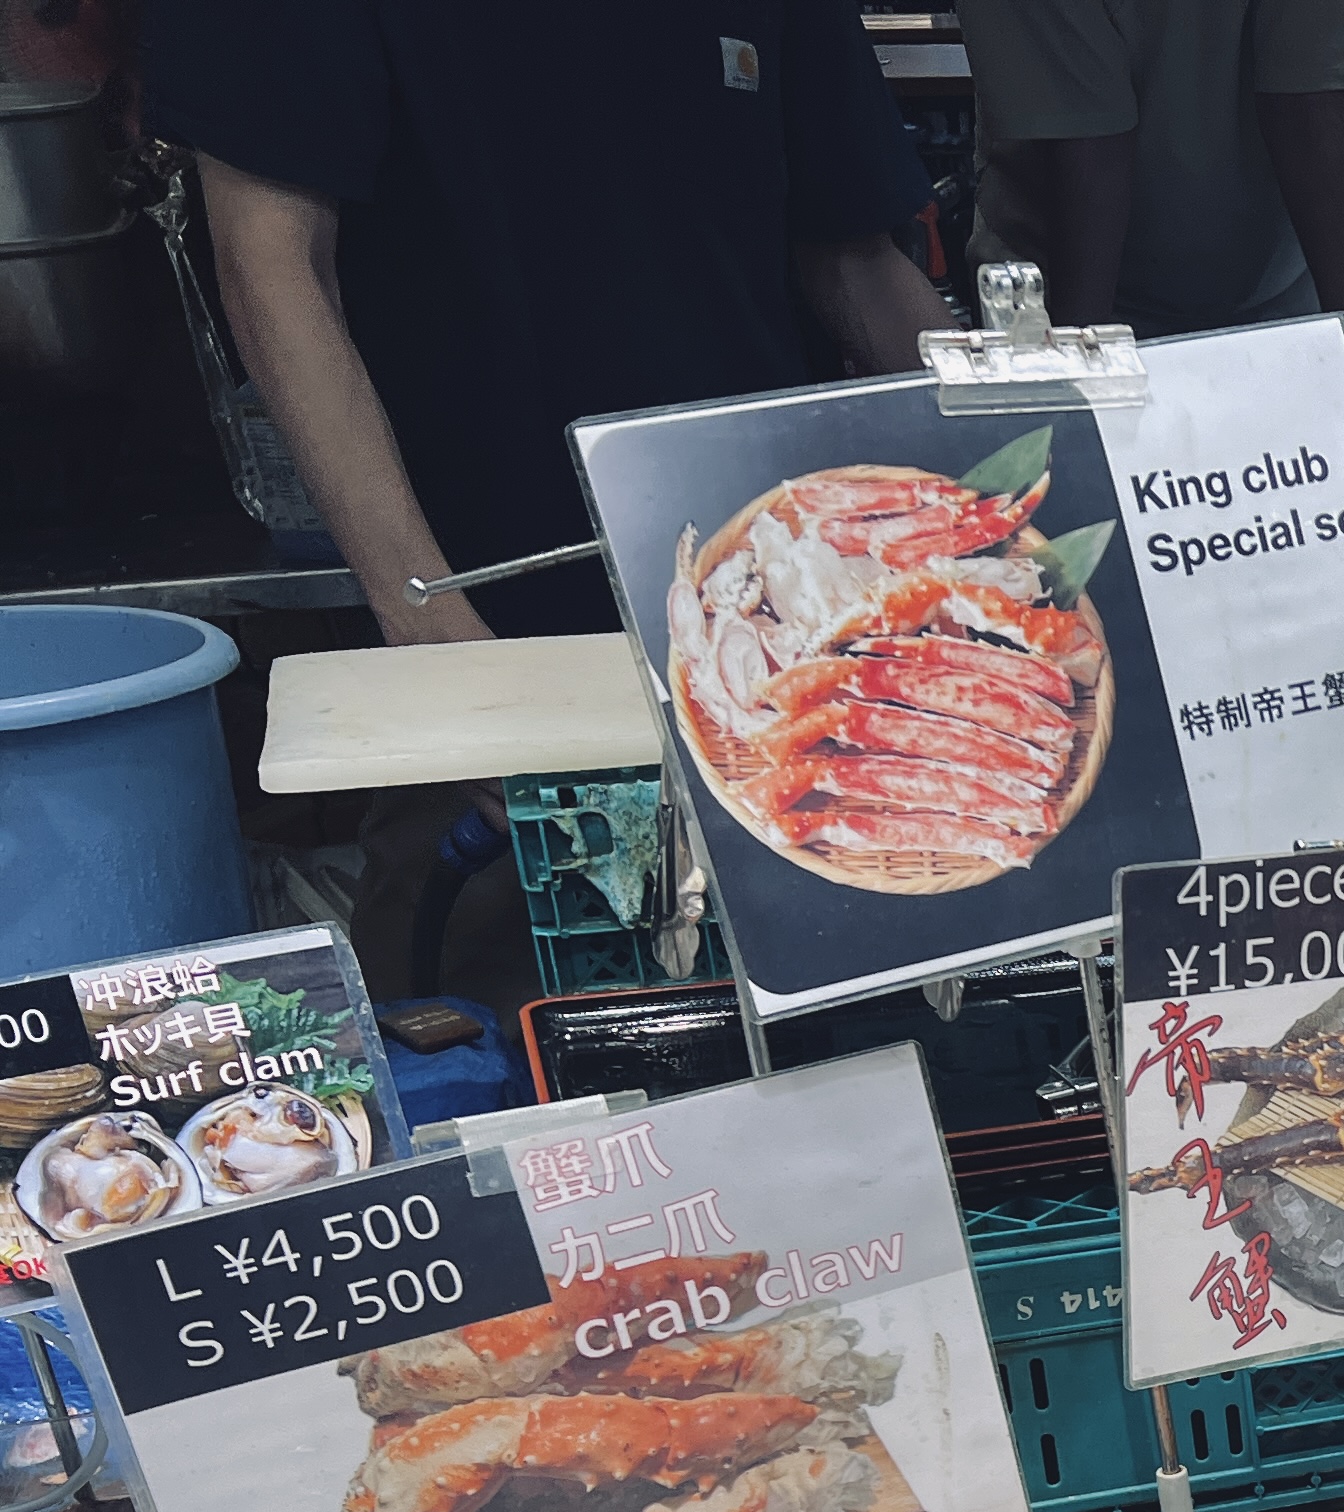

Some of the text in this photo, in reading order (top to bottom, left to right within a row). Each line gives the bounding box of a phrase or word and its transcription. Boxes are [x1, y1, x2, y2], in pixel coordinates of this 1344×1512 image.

[1131, 446, 1331, 513] King club
[1148, 508, 1306, 575] Special
[78, 956, 221, 1013] 冲浪蛤
[95, 1003, 251, 1063] ホッキ貝
[111, 1045, 324, 1107] Surf clam
[518, 1119, 673, 1214] 蟹爪
[156, 1193, 442, 1302] L ¥4,500
[549, 1188, 736, 1291] カニ爪
[179, 1258, 465, 1369] S ¥2,500
[574, 1229, 905, 1361] crab claw
